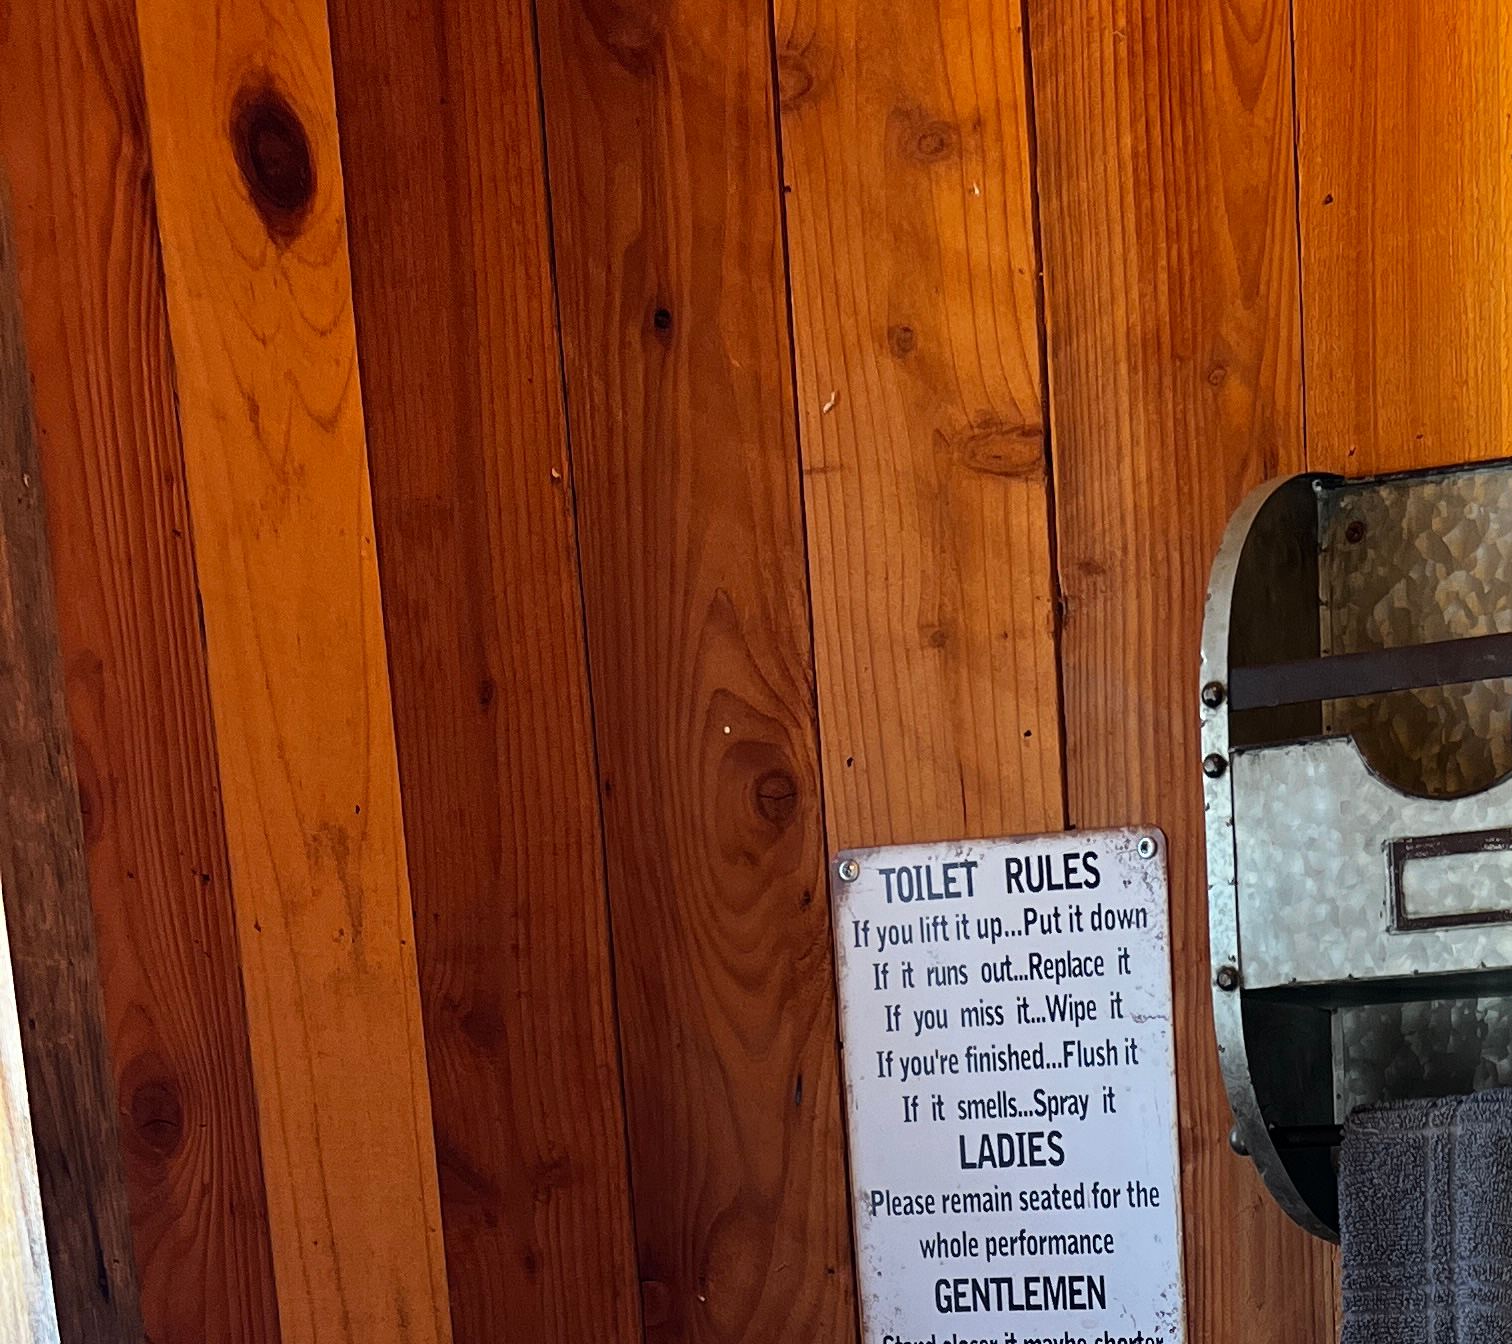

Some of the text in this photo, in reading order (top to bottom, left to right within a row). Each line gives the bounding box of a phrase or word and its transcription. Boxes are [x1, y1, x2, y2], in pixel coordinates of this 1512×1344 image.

[879, 851, 1101, 904] TOILET RULES
[852, 919, 869, 948] If
[877, 922, 913, 952] you
[919, 915, 950, 943] lift
[955, 914, 971, 940] it
[1068, 904, 1084, 933] it
[1091, 903, 1148, 931] down
[872, 962, 889, 990] If
[901, 961, 915, 989] it
[927, 965, 968, 987] runs
[1118, 947, 1131, 976] it
[885, 1004, 902, 1032] If
[913, 1008, 948, 1036] you
[960, 999, 1004, 1028] miss
[1109, 992, 1124, 1020] it
[876, 1050, 893, 1078] If
[900, 1049, 959, 1082] you're
[1125, 1038, 1139, 1066] it
[902, 1095, 919, 1123] If
[931, 1093, 945, 1121] it
[1102, 1086, 1116, 1114] it
[959, 1130, 1065, 1169] LADIES
[871, 1180, 1160, 1217] Please remain seated for the
[919, 1229, 1114, 1262] whole performance
[935, 1275, 1107, 1313] GENTLEMEN
